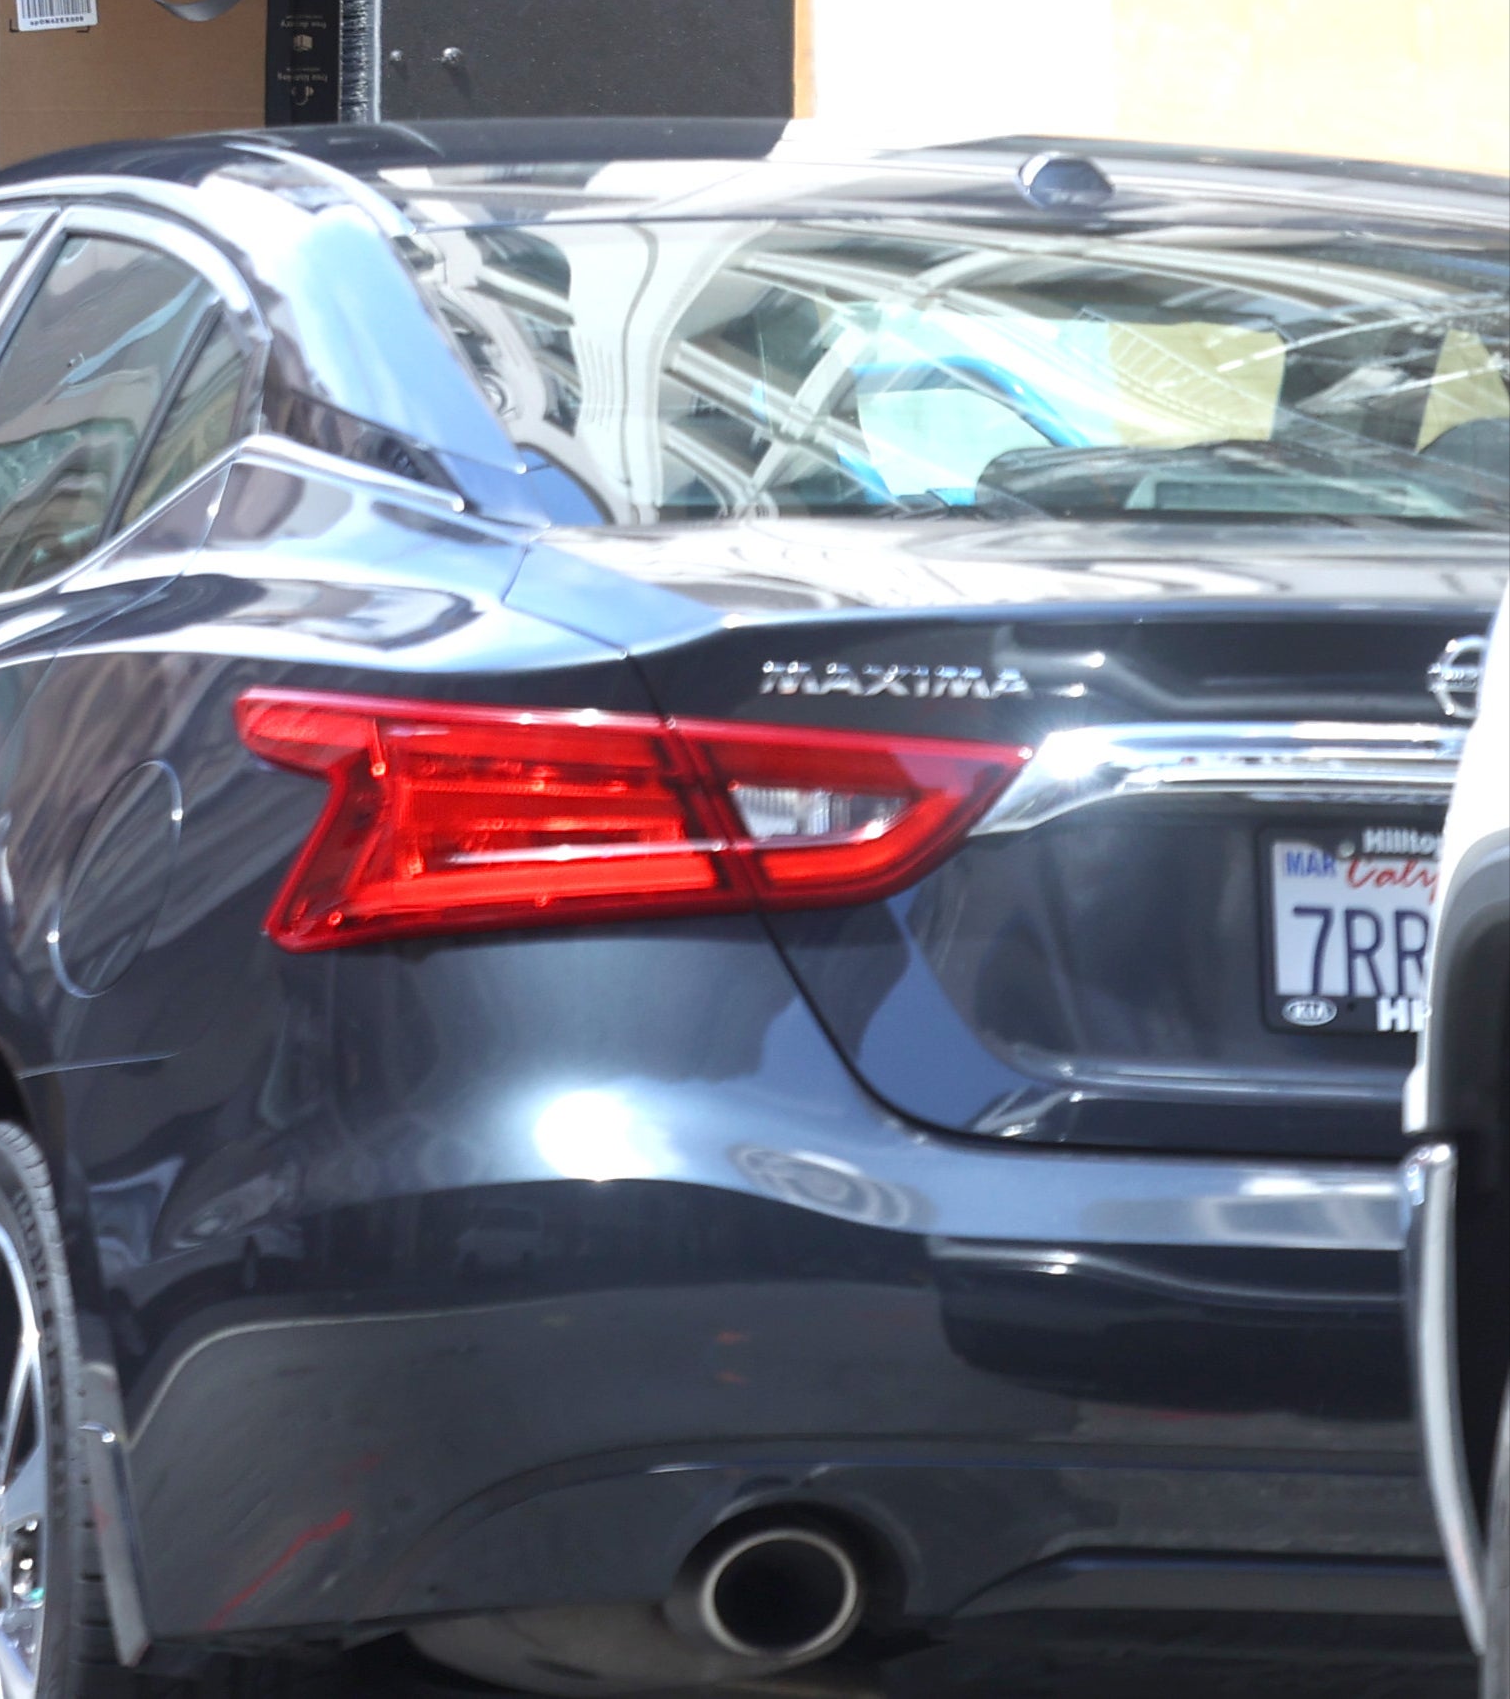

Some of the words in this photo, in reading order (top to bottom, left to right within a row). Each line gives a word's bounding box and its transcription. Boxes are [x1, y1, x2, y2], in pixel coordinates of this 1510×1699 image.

[760, 660, 1030, 699] MAXIMA
[1286, 852, 1335, 877] MAR
[1294, 1005, 1329, 1020] KIA
